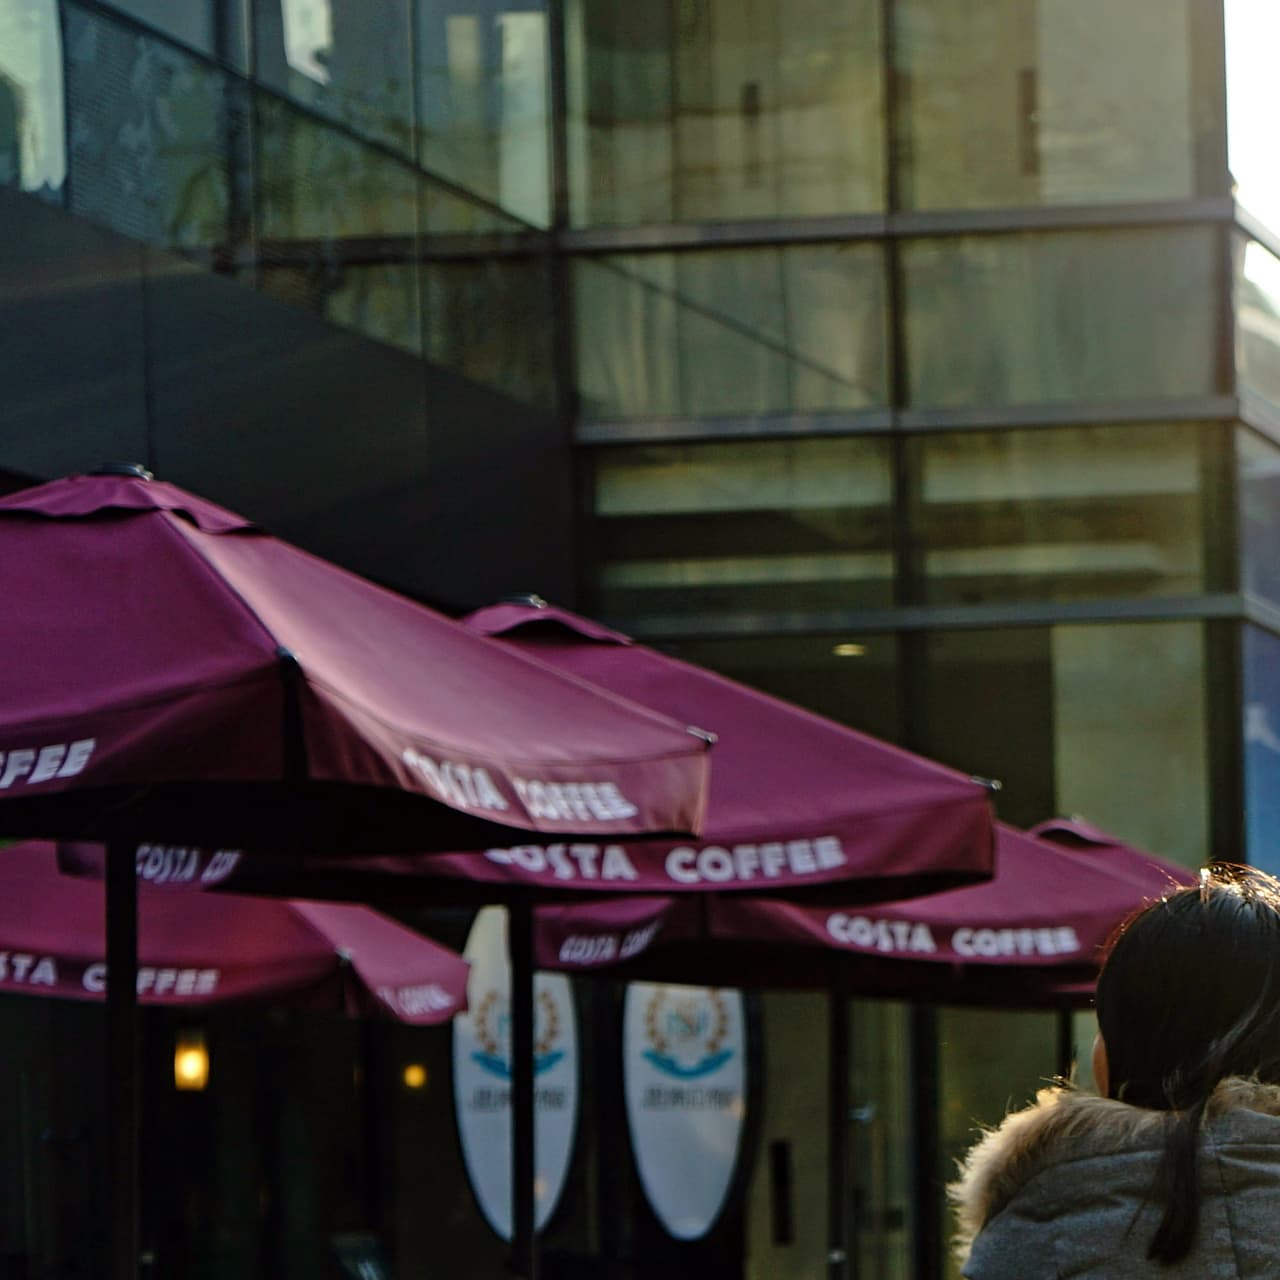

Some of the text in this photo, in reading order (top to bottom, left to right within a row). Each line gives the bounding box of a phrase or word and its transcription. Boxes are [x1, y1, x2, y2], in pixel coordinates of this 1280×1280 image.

[0, 738, 97, 789] FEE
[512, 777, 638, 822] COFFEE
[664, 836, 847, 883] COFFEE
[827, 912, 1081, 957] COSTA COFFEE
[82, 962, 221, 996] CFFEE
